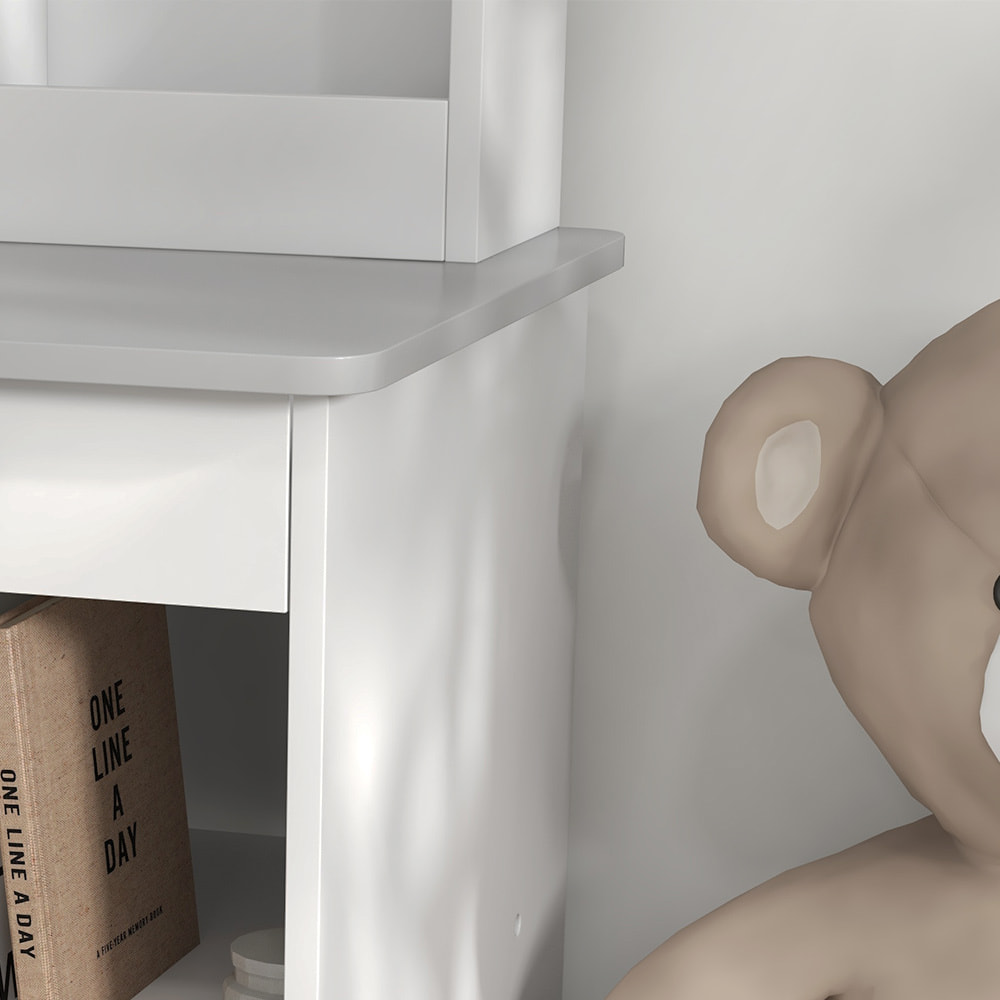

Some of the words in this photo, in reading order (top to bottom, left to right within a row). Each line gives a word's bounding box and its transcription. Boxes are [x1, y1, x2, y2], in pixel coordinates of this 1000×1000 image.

[89, 679, 126, 732] ONE
[91, 725, 133, 783] LINE
[0, 769, 21, 816] ONE
[113, 783, 125, 821] A
[6, 828, 28, 881] LINE
[103, 821, 138, 876] DAY
[13, 890, 30, 905] A
[16, 913, 36, 959] DAY
